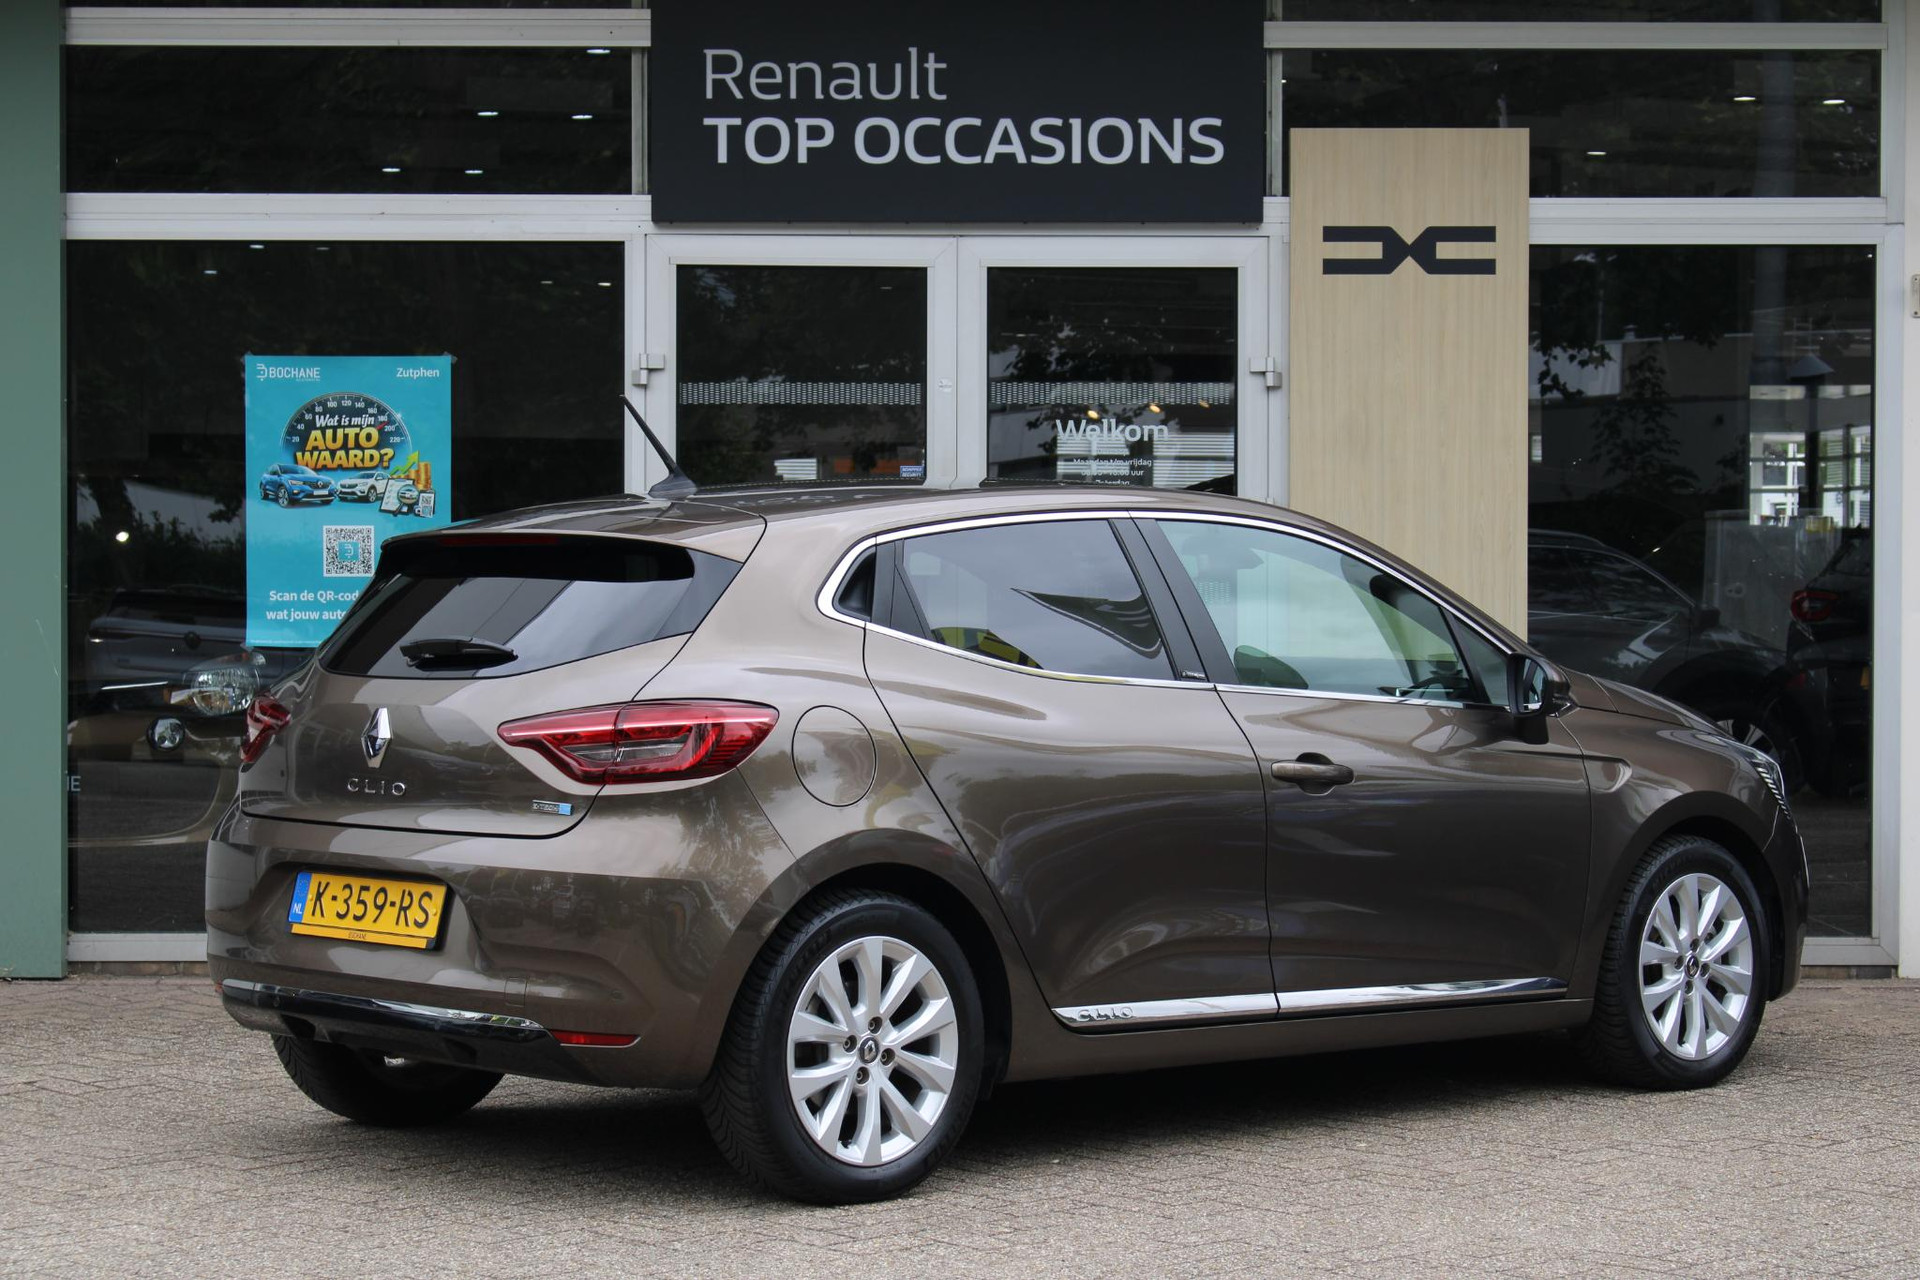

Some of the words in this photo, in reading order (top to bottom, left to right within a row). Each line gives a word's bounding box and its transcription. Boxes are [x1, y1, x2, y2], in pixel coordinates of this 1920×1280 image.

[703, 47, 948, 100] Renault
[703, 116, 835, 164] TOP
[854, 116, 1225, 165] OCCASIONS
[269, 367, 321, 378] BOCHANE
[396, 367, 440, 380] Zutphen
[355, 401, 366, 409] 140
[315, 414, 340, 428] Wat
[341, 414, 350, 426] is
[351, 414, 375, 428] mijn
[1055, 418, 1169, 442] Welkom
[305, 426, 379, 451] AUTO
[295, 447, 395, 469] WAARD?
[1126, 458, 1152, 467] vrijdag
[269, 590, 297, 601] Scan
[300, 590, 315, 601] de
[266, 609, 288, 620] wat
[290, 608, 319, 622] jouw
[347, 777, 406, 796] CLIO
[292, 902, 303, 915] NL
[311, 880, 433, 929] K-359-RS
[1078, 1006, 1134, 1022] CLIO
